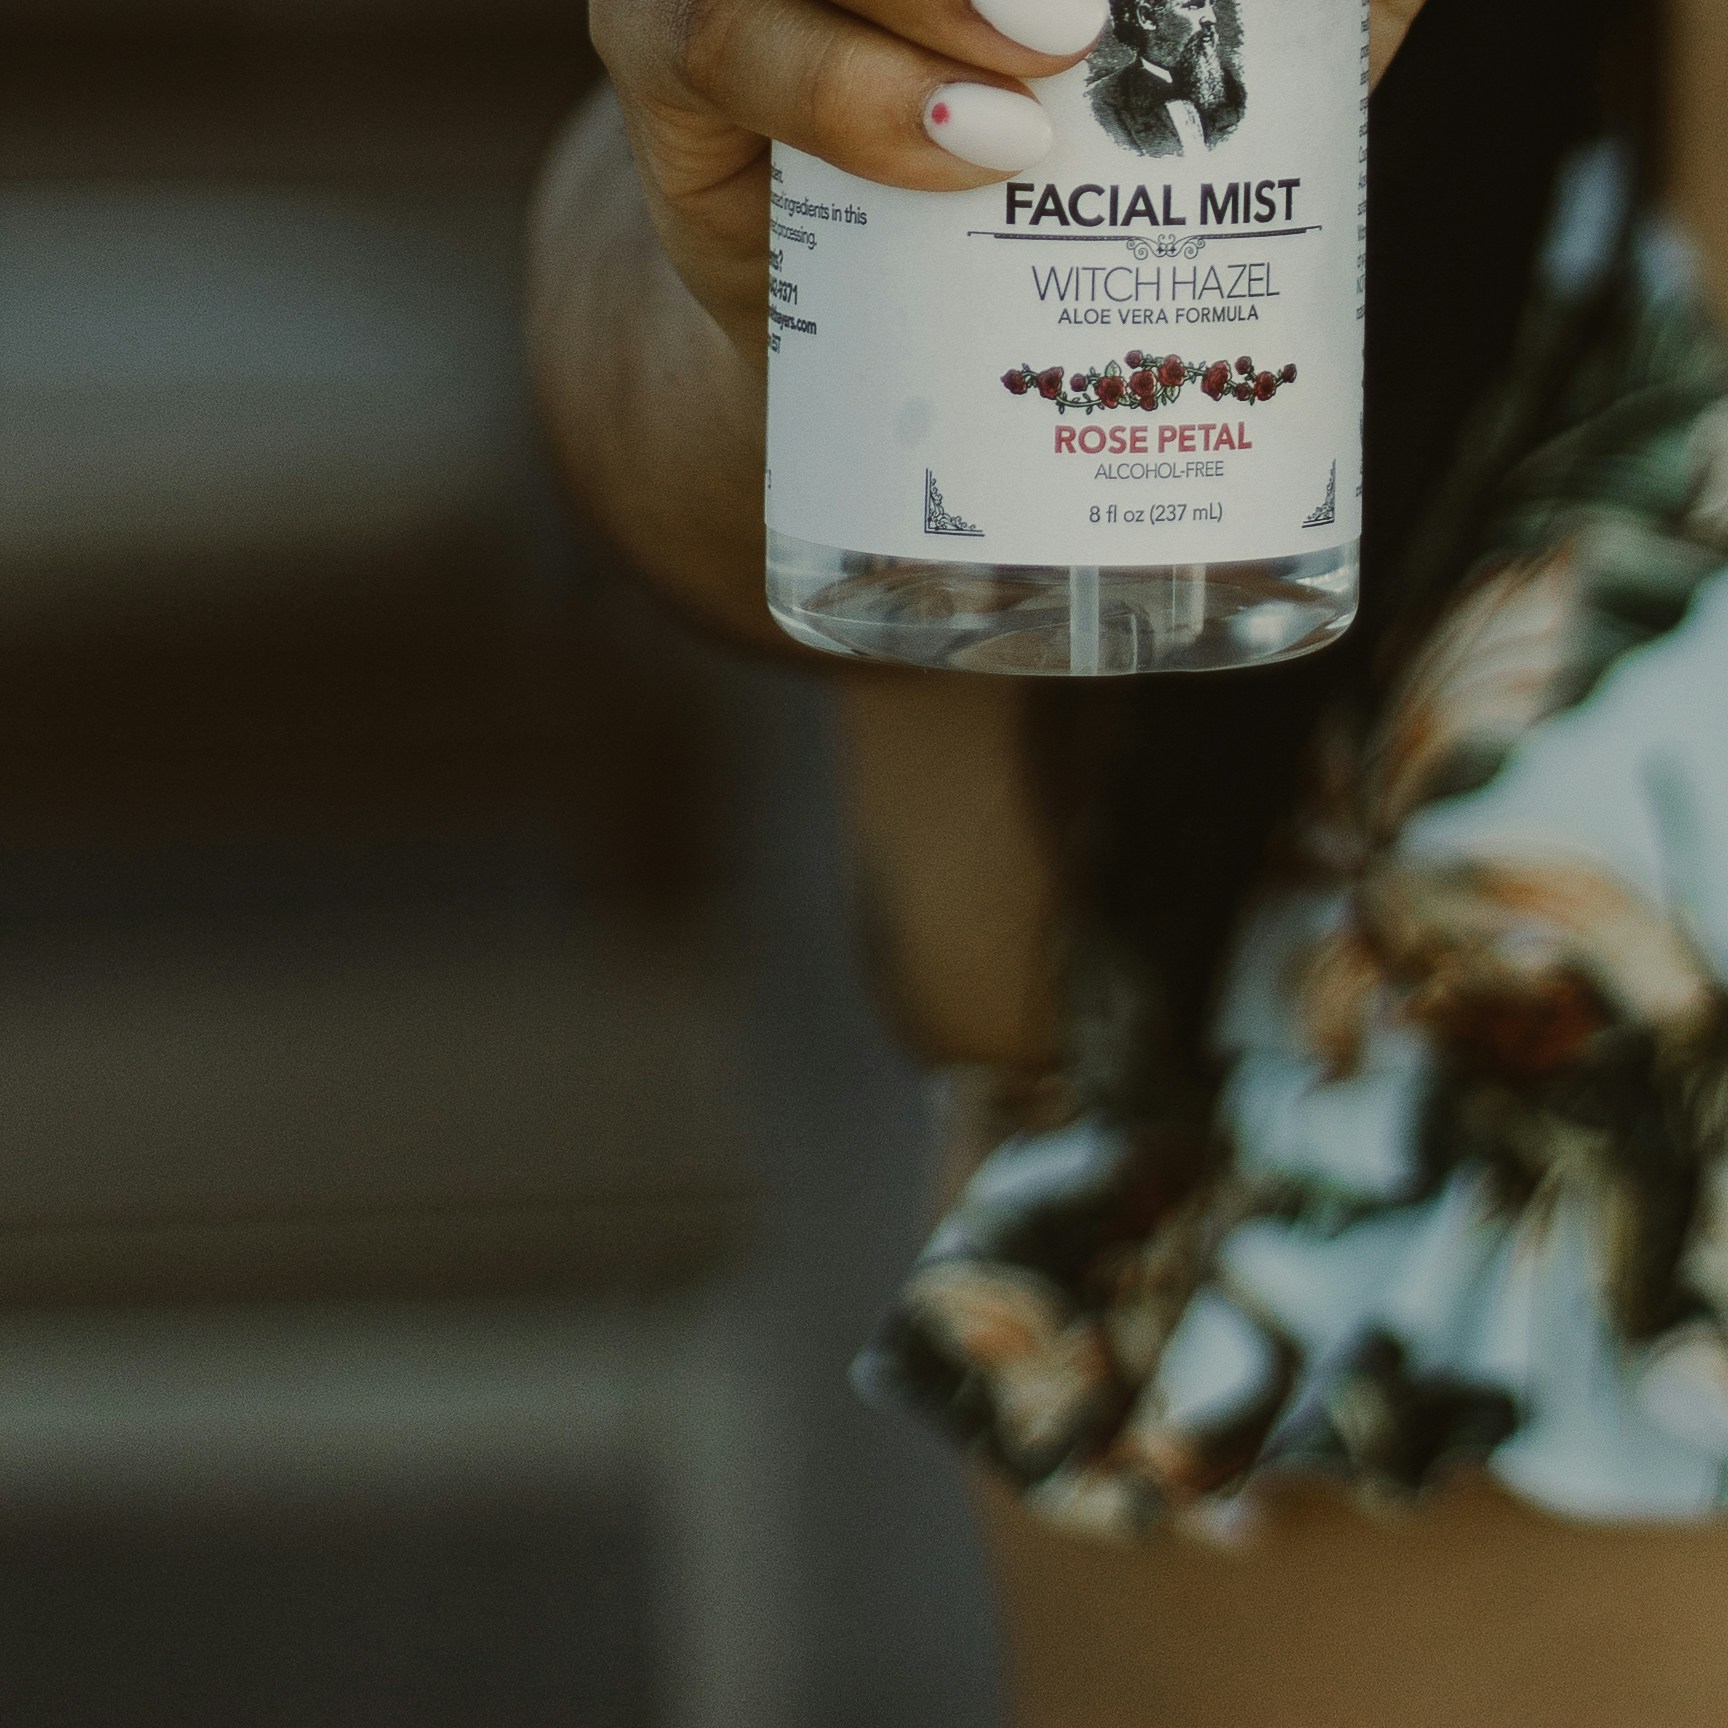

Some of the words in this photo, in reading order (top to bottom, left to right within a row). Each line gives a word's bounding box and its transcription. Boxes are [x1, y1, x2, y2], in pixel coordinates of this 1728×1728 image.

[844, 204, 868, 225] this
[1005, 181, 1186, 227] FACIAL
[1200, 178, 1301, 224] MIST
[1032, 265, 1160, 303] WITCH
[1171, 261, 1280, 301] HAZEL
[1058, 308, 1110, 325] ALOE
[1118, 308, 1169, 325] VERA
[1176, 305, 1259, 324] FORMULA
[1054, 425, 1149, 455] ROSE
[1158, 422, 1253, 454] PETAL
[1095, 461, 1225, 481] ALCOHOL-FREE
[1089, 506, 1101, 524] 8
[1106, 504, 1118, 523] fl
[1124, 511, 1145, 523] oz
[1150, 504, 1187, 526] (237
[1193, 502, 1224, 524] mL)
